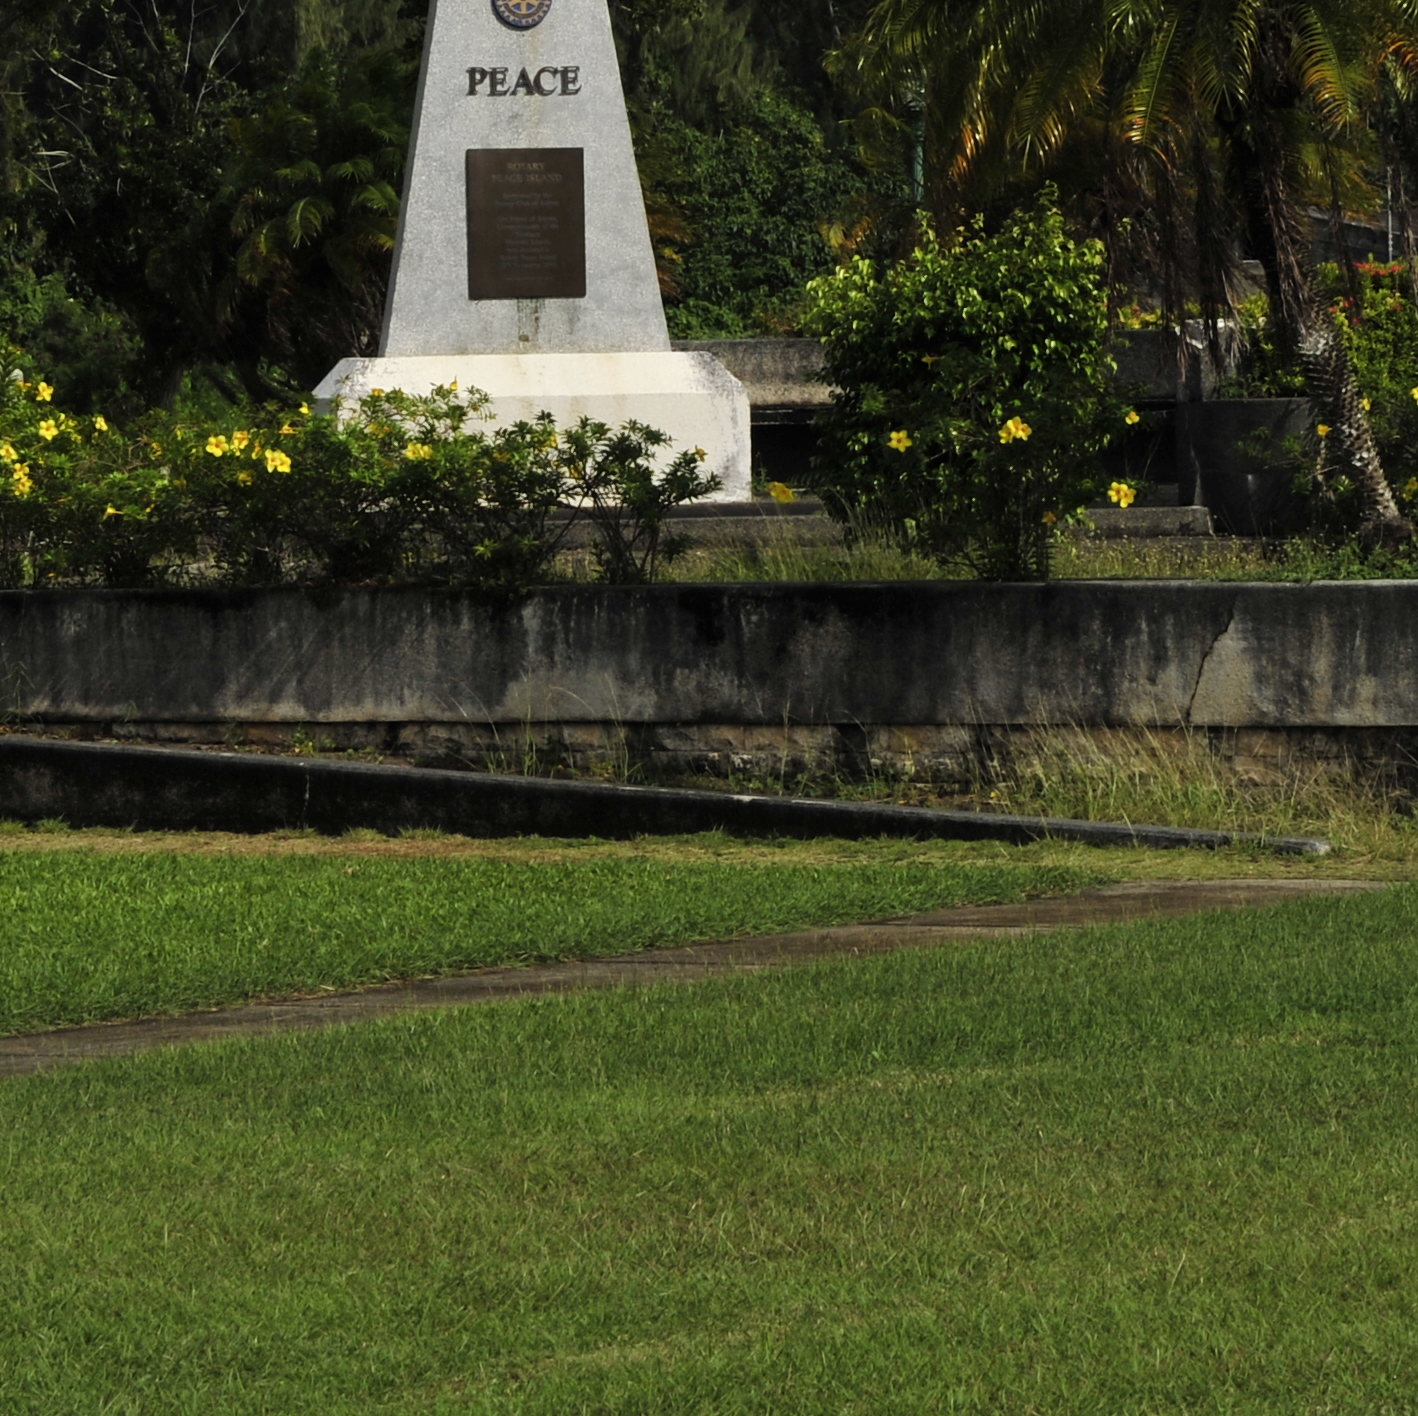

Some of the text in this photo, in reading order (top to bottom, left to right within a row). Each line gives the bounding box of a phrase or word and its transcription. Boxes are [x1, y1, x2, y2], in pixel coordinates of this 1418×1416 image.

[465, 66, 582, 97] PEACE
[507, 162, 544, 171] ROTARY
[491, 174, 562, 183] PEACE ISLAND
